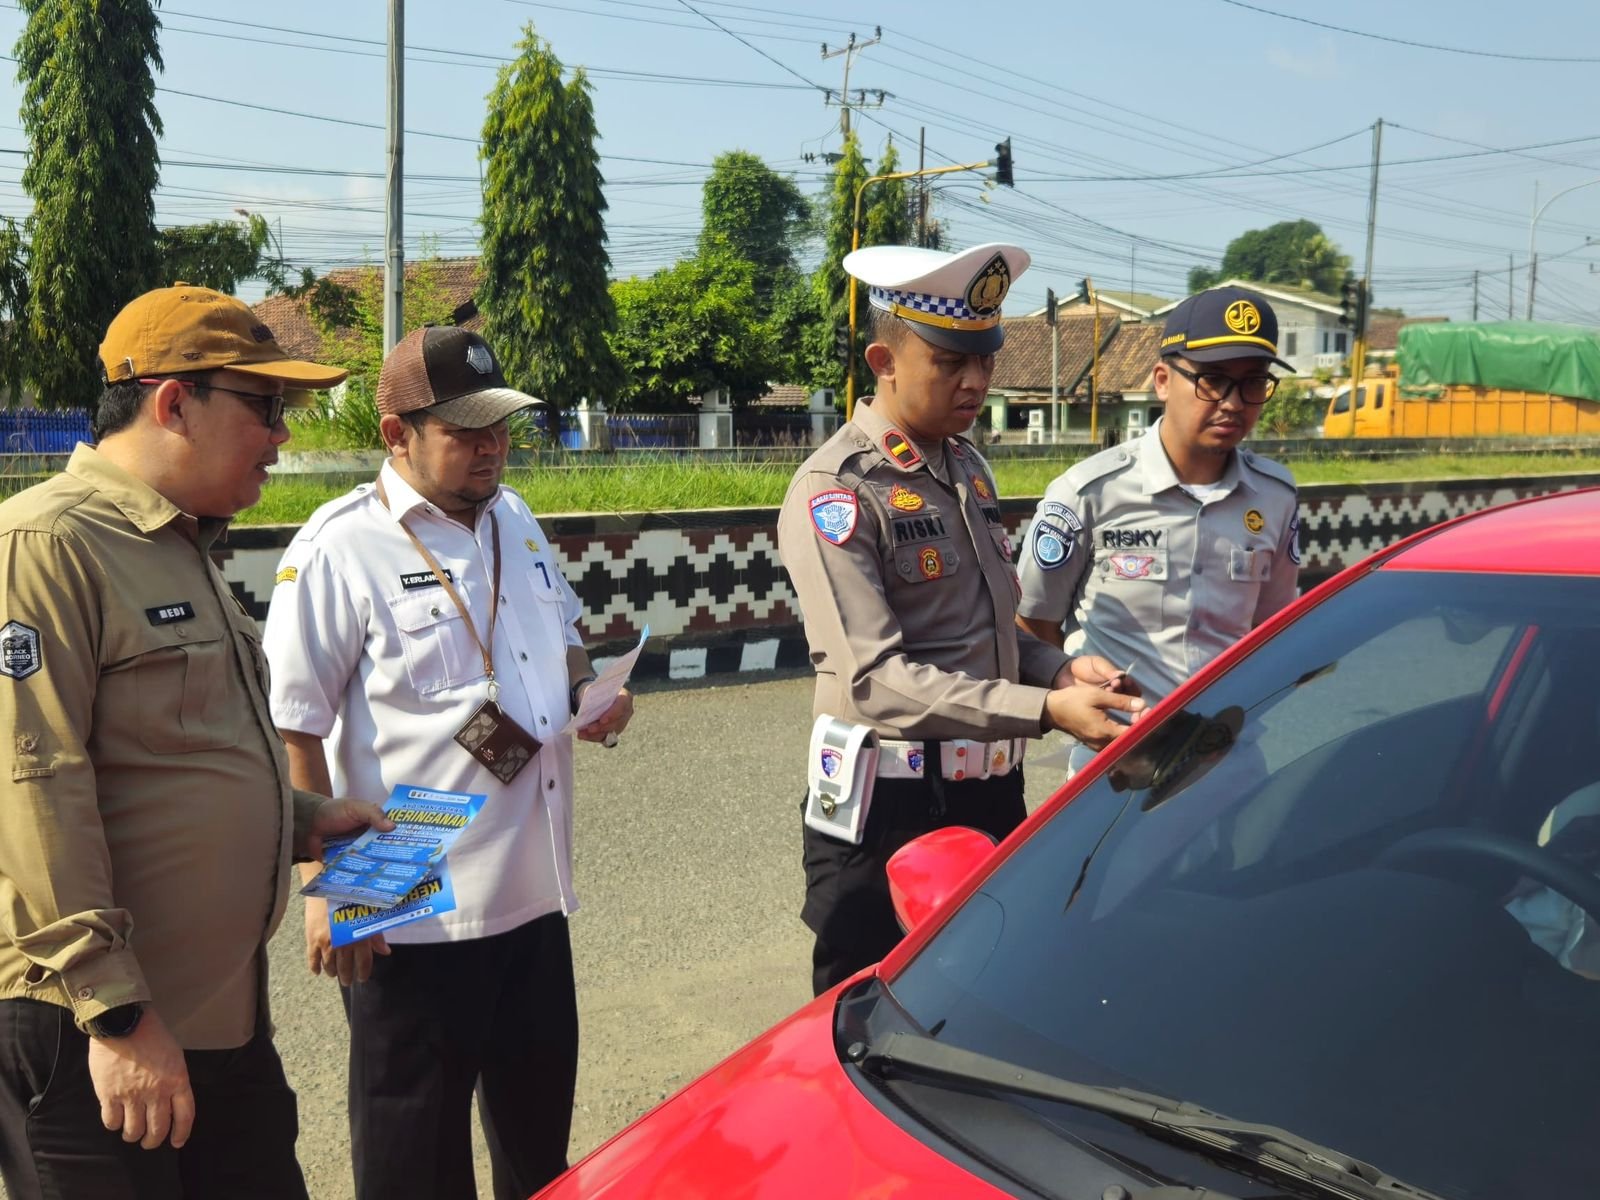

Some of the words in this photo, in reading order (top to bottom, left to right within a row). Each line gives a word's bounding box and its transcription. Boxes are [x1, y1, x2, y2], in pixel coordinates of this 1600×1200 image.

[895, 517, 946, 541] RISKI
[1102, 529, 1162, 549] RISKY
[387, 808, 470, 827] KERINGANAN
